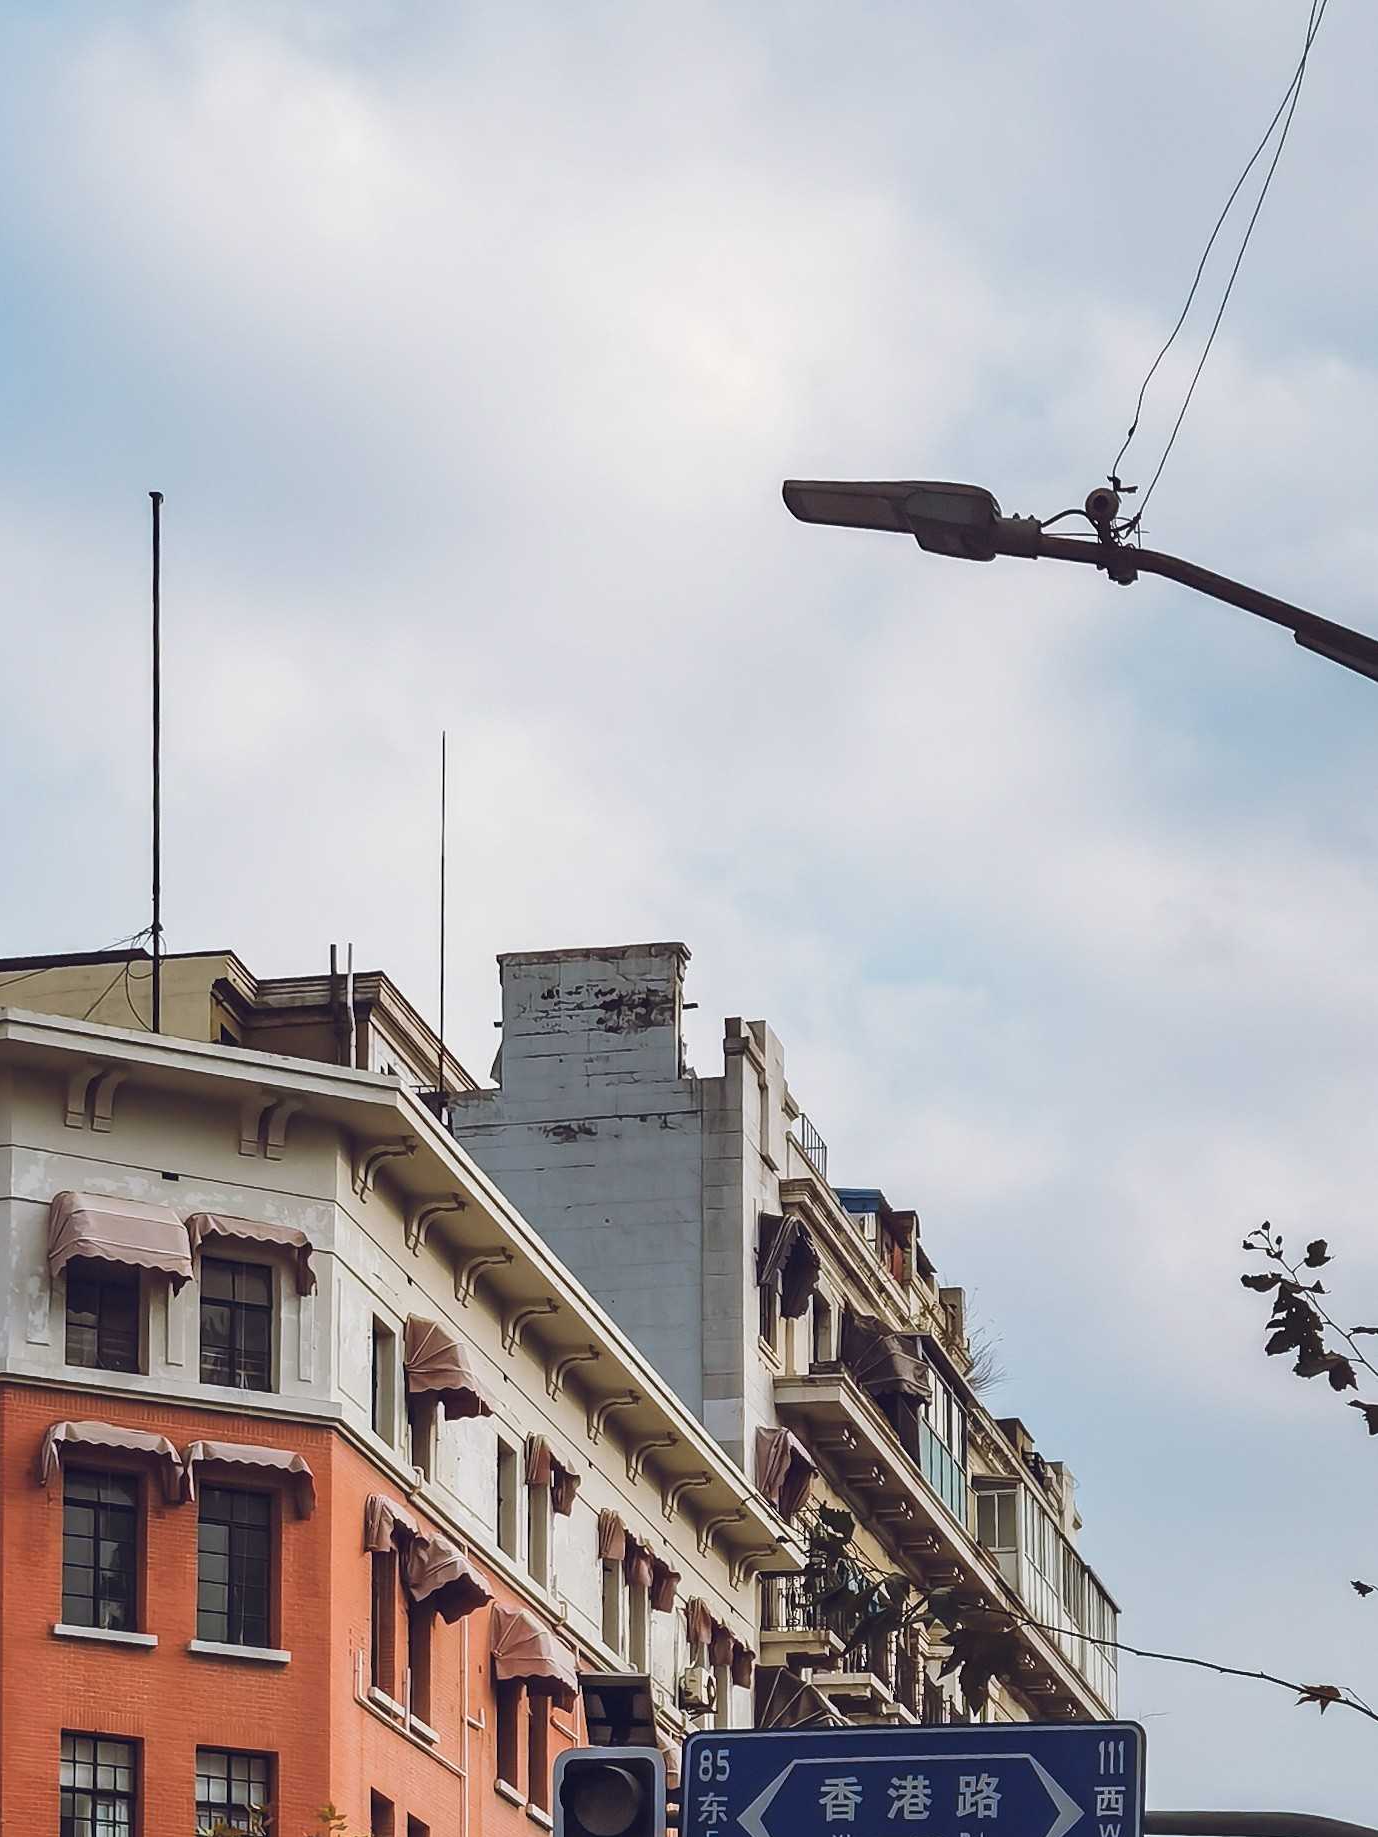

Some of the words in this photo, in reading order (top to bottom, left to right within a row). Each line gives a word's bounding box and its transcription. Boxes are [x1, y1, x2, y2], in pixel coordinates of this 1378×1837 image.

[698, 1748, 731, 1782] 85
[1098, 1740, 1125, 1775] 111
[697, 1792, 728, 1825] 东
[818, 1772, 1003, 1823] 香港路
[1093, 1785, 1127, 1817] 西
